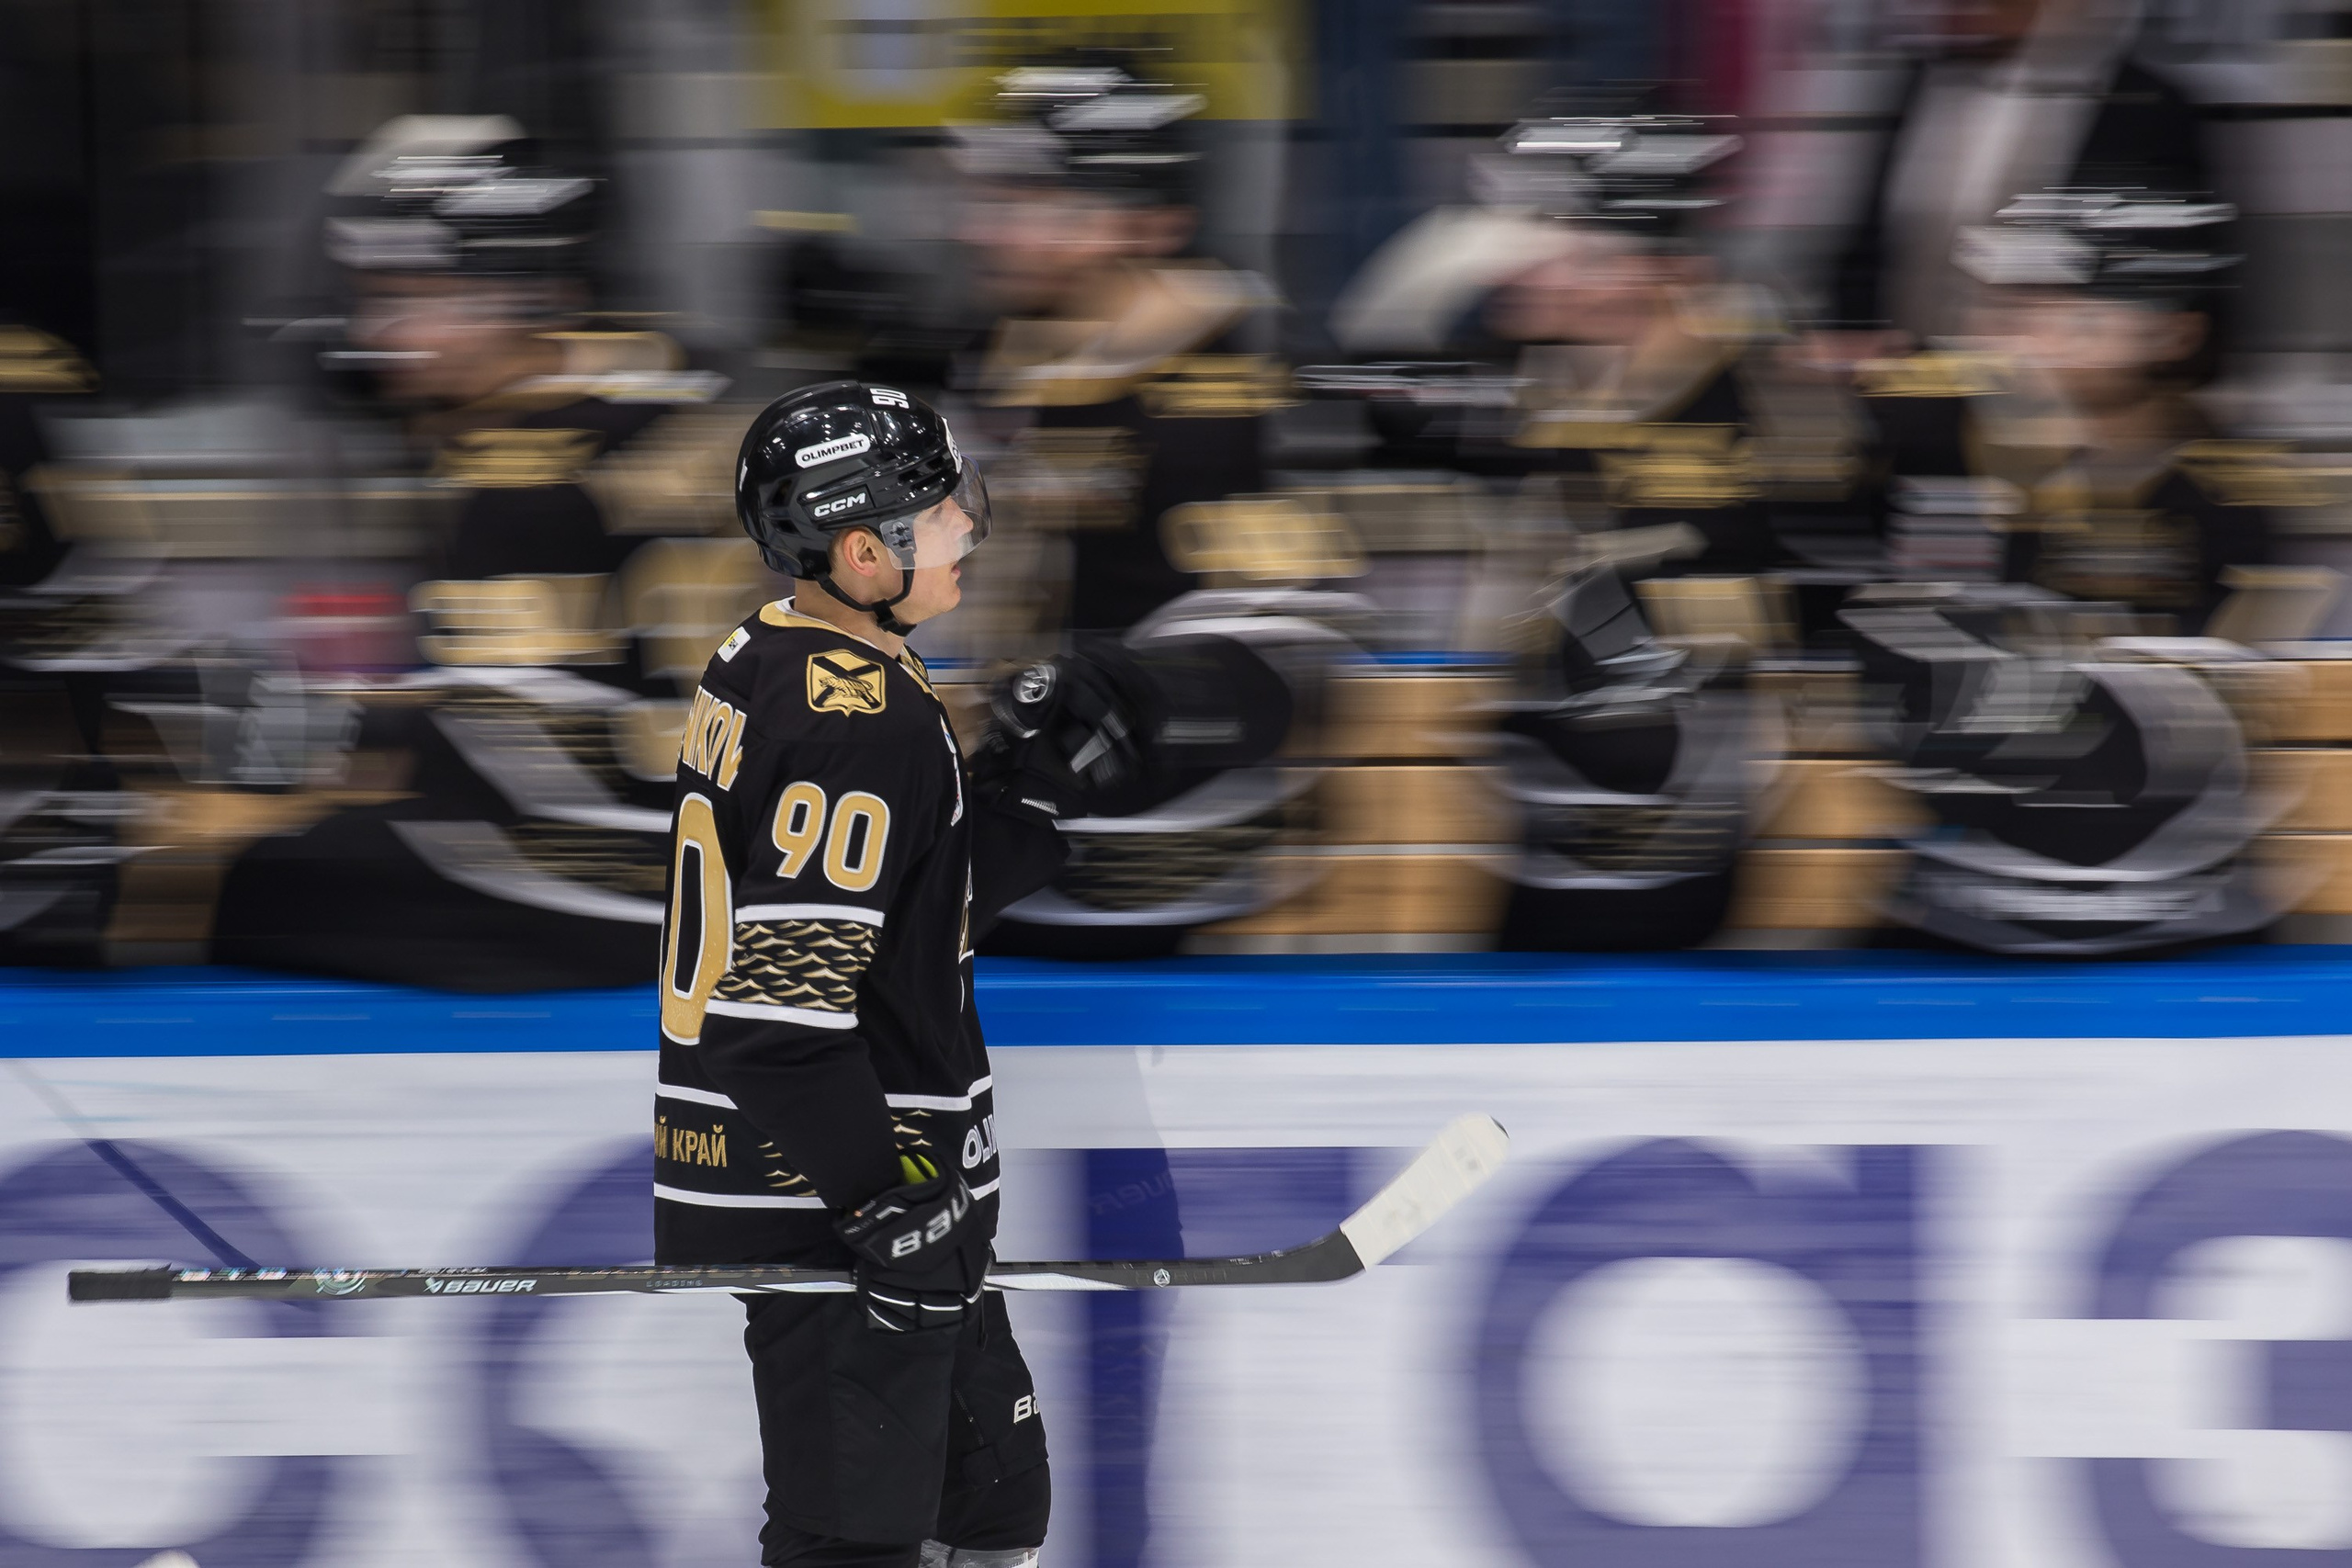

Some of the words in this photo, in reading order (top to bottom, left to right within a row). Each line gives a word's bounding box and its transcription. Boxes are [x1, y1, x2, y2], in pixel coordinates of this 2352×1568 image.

[869, 388, 910, 409] 90
[801, 438, 865, 462] OLIMPBET
[814, 492, 866, 517] CCM
[772, 781, 890, 891] 90
[672, 1124, 727, 1168] КРАЙ
[443, 1279, 538, 1293] BAUER
